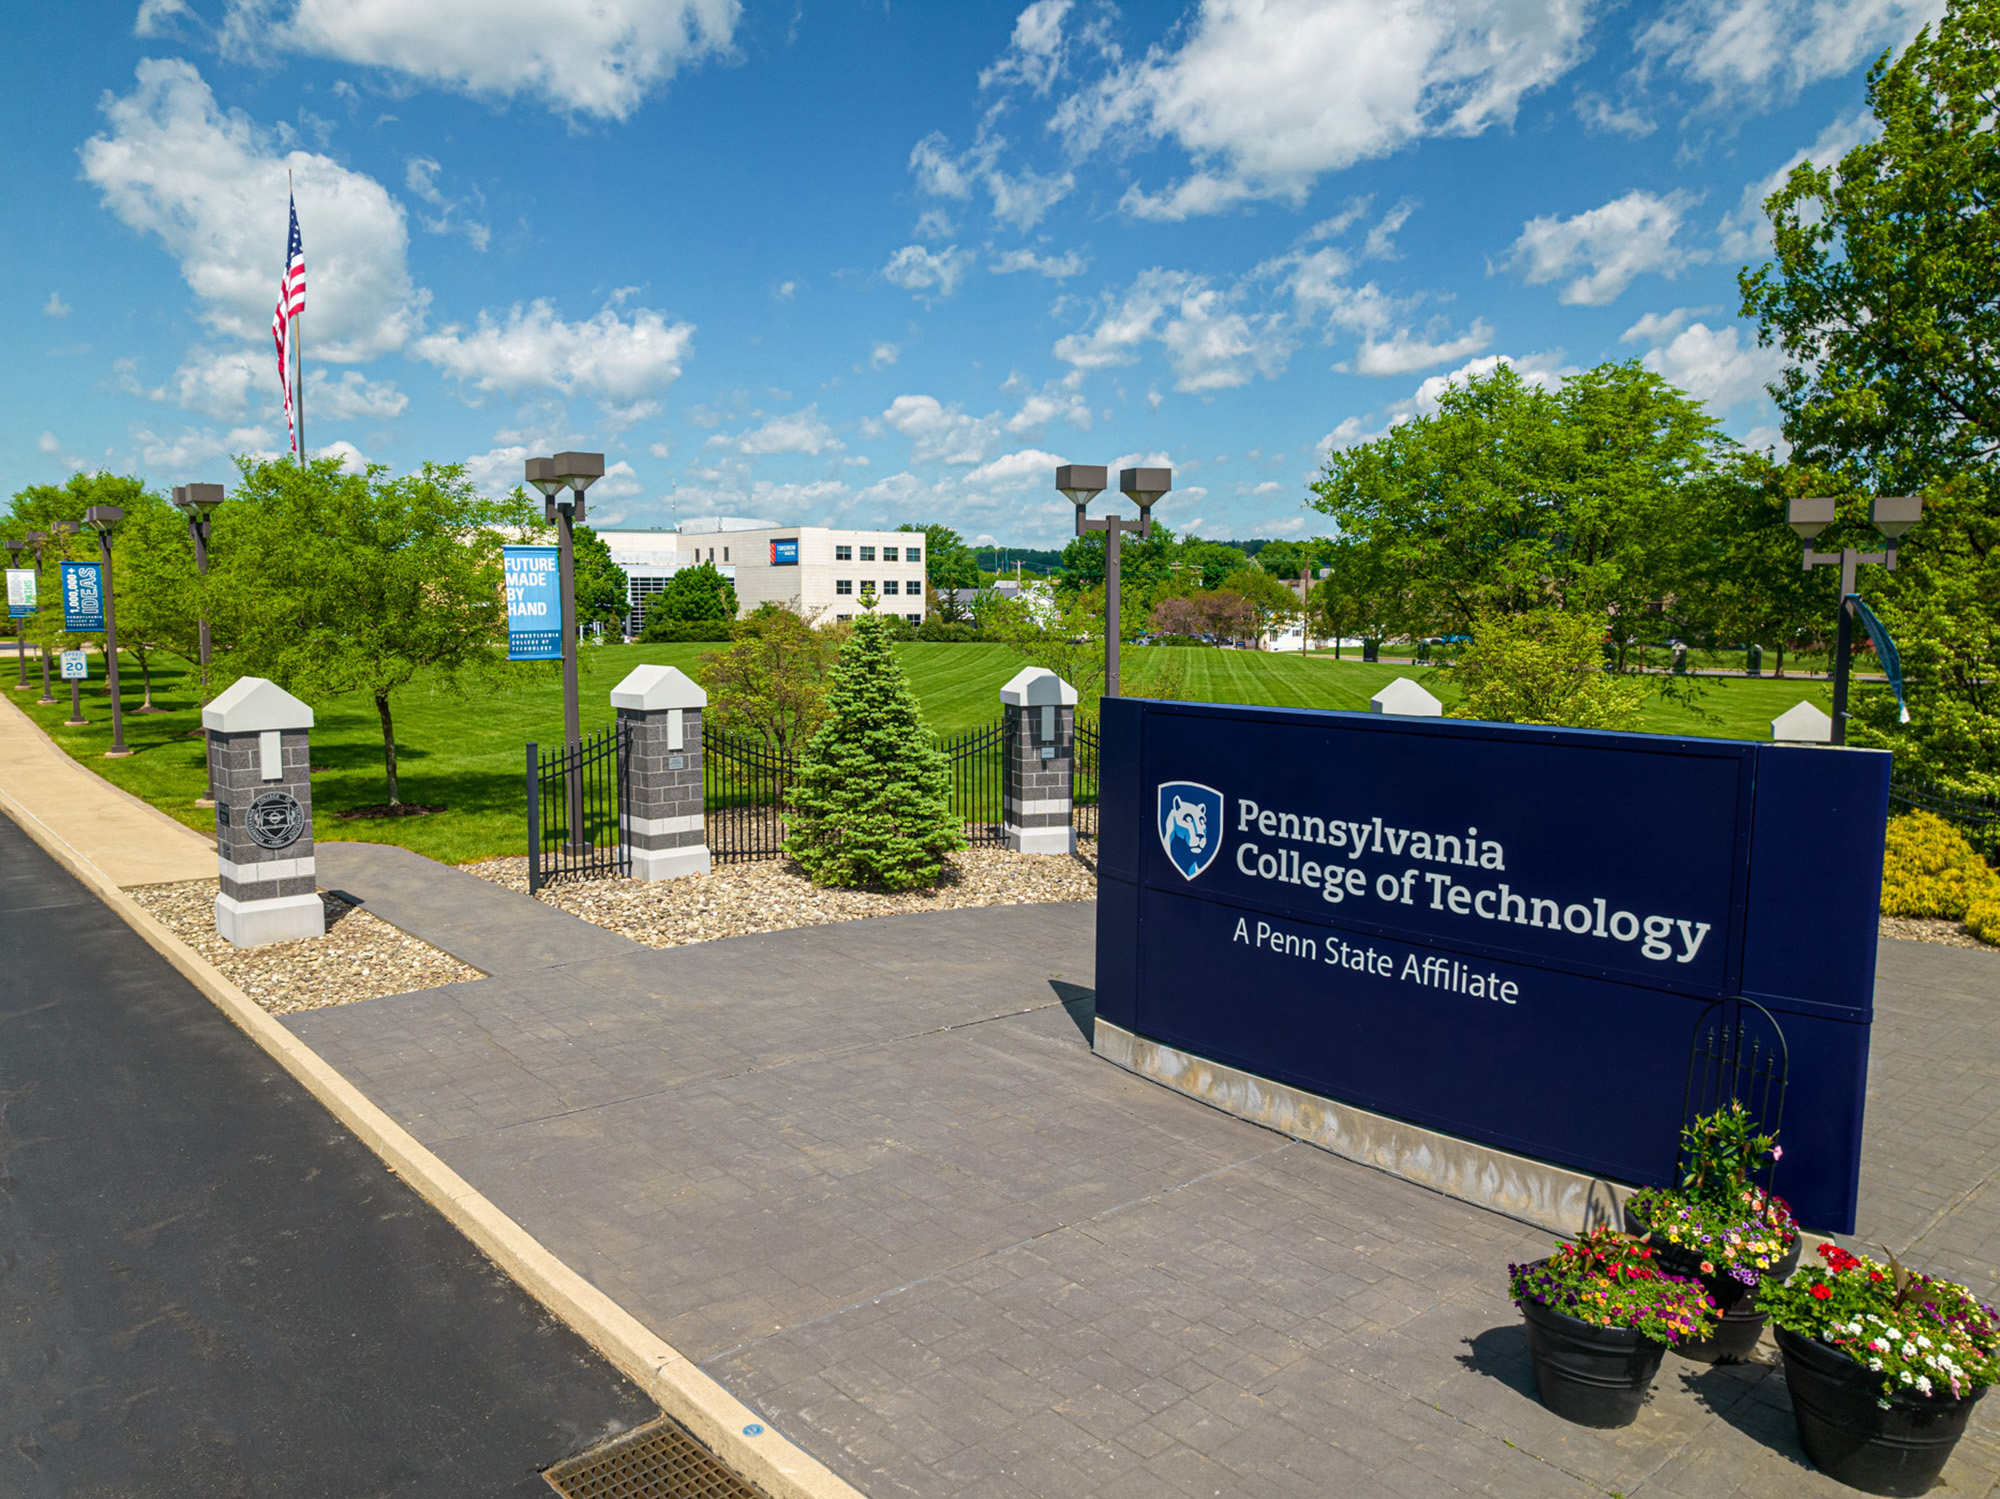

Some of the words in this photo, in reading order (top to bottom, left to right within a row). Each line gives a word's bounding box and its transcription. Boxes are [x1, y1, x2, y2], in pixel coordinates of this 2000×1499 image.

[504, 557, 556, 572] FUTURE
[505, 572, 547, 587] MADE
[66, 567, 80, 613] 1,000,000+
[78, 567, 99, 614] IDEAS
[506, 587, 525, 601] BY
[507, 602, 547, 616] HAND
[66, 662, 83, 671] 20
[257, 794, 280, 805] COLLEGE
[1237, 797, 1507, 872] Pennsylvania
[1236, 842, 1368, 904] College
[1376, 868, 1420, 906] of
[1424, 872, 1712, 965] Technology
[1232, 917, 1250, 945] A
[1256, 921, 1317, 961] Penn
[1324, 936, 1394, 977] State
[1400, 952, 1520, 1005] Affiliate
